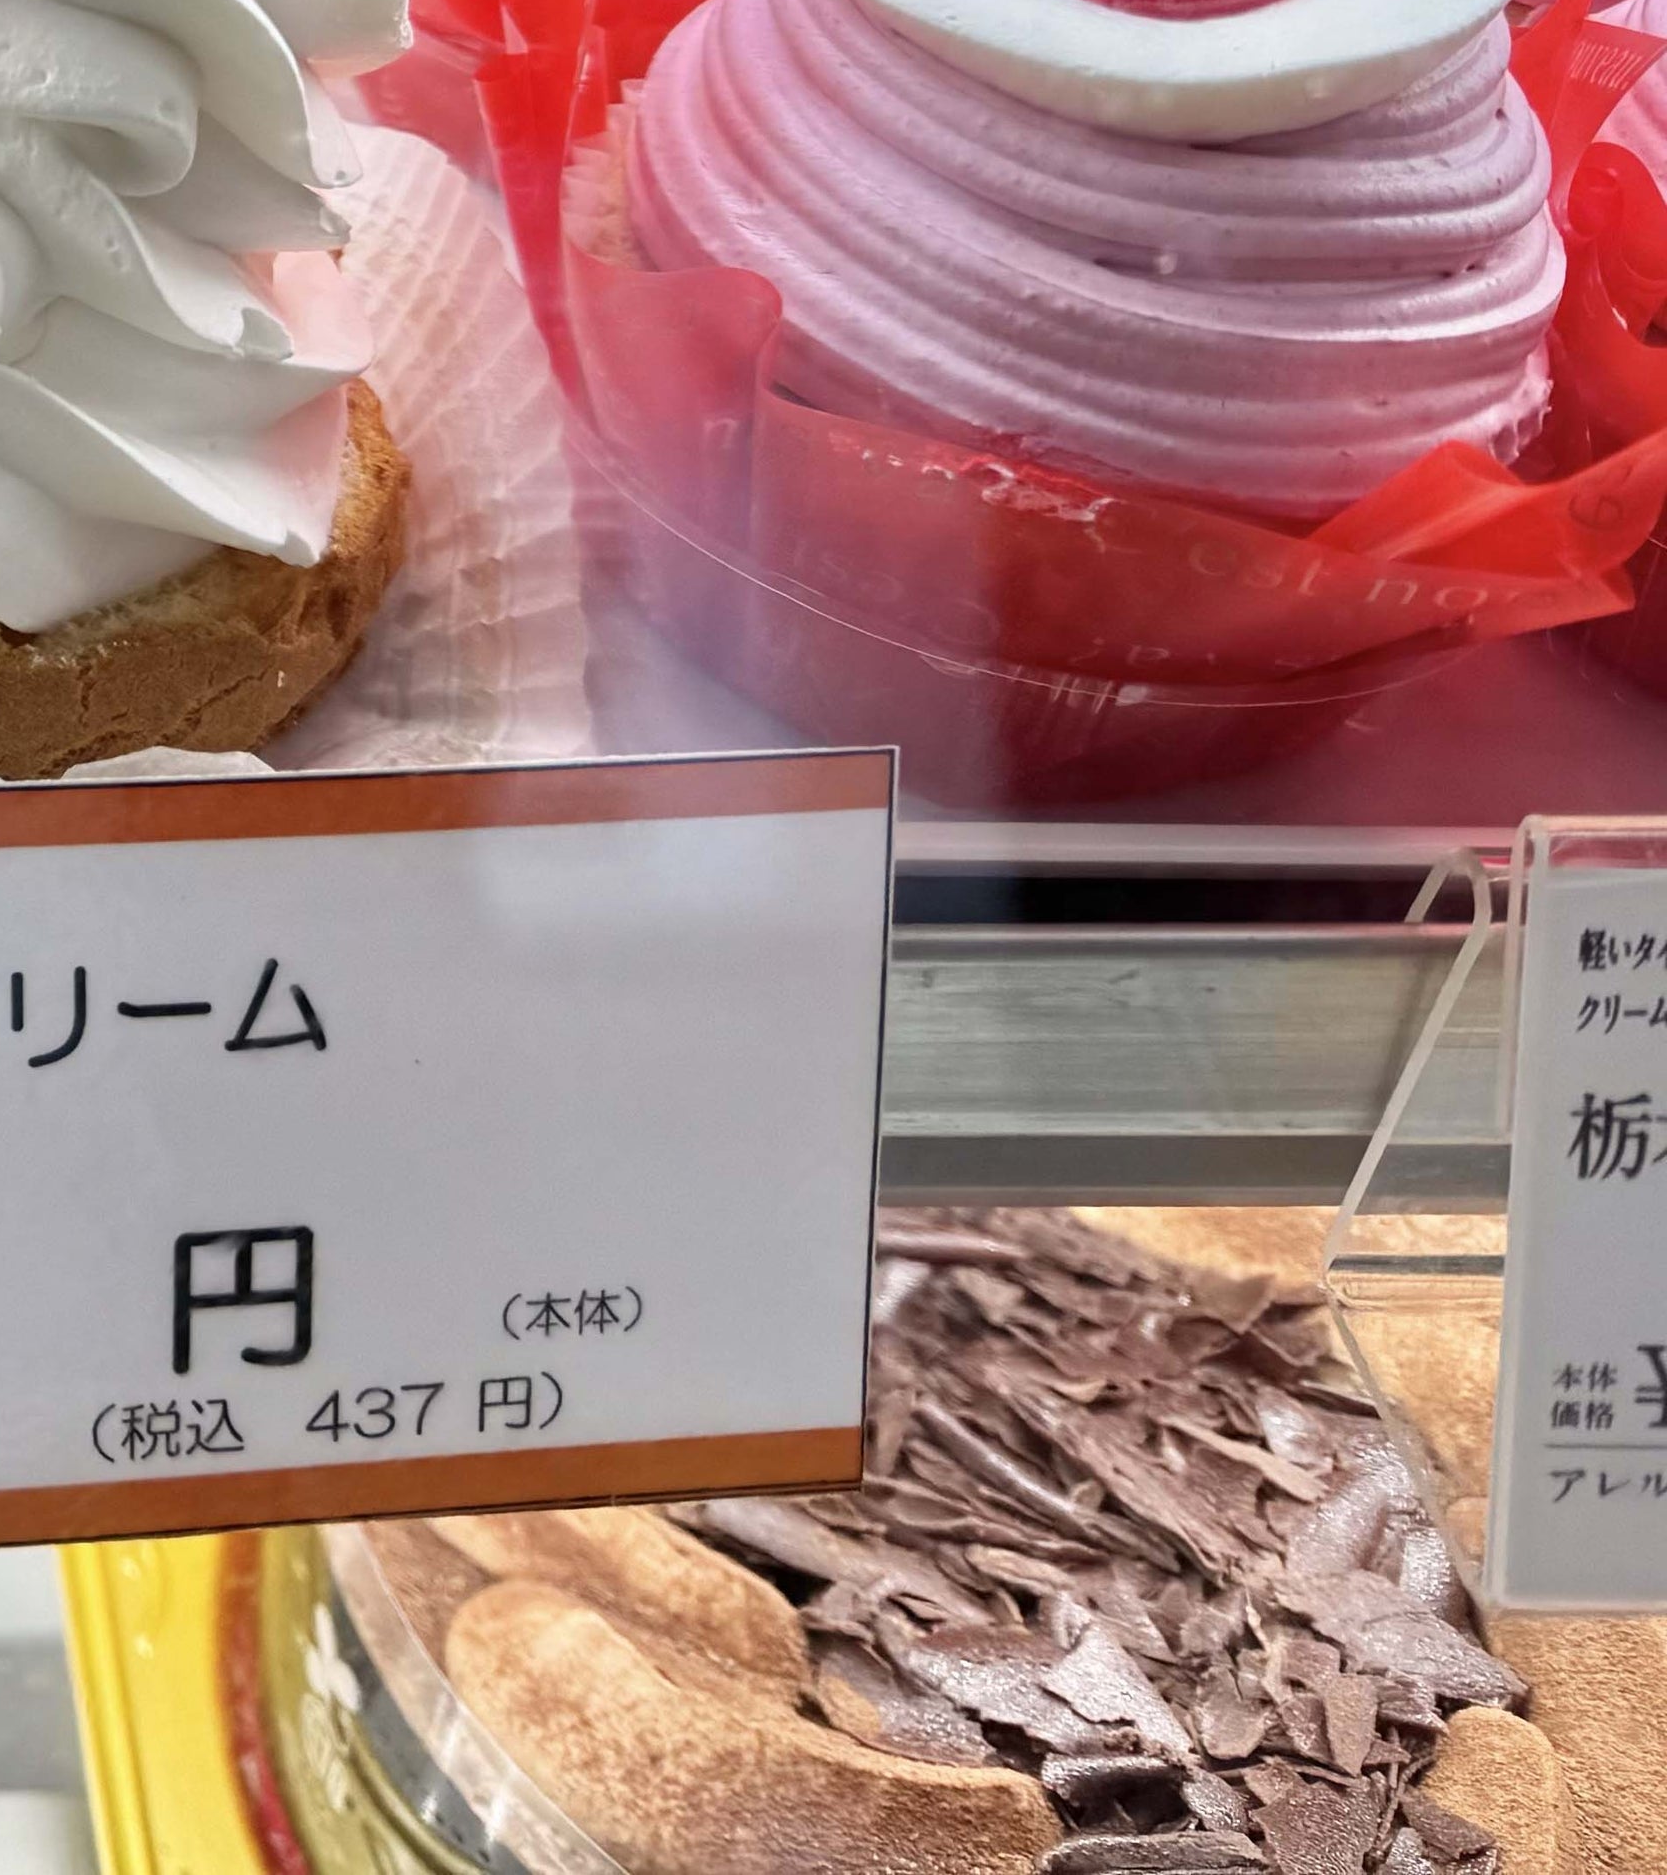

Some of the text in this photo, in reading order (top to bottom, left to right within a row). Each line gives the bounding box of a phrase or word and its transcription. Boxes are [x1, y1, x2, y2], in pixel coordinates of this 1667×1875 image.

[1567, 1093, 1667, 1181] 栃
[173, 1226, 314, 1375] 円
[501, 1286, 643, 1341] (本体)
[91, 1370, 565, 1463] (税込 437 円)
